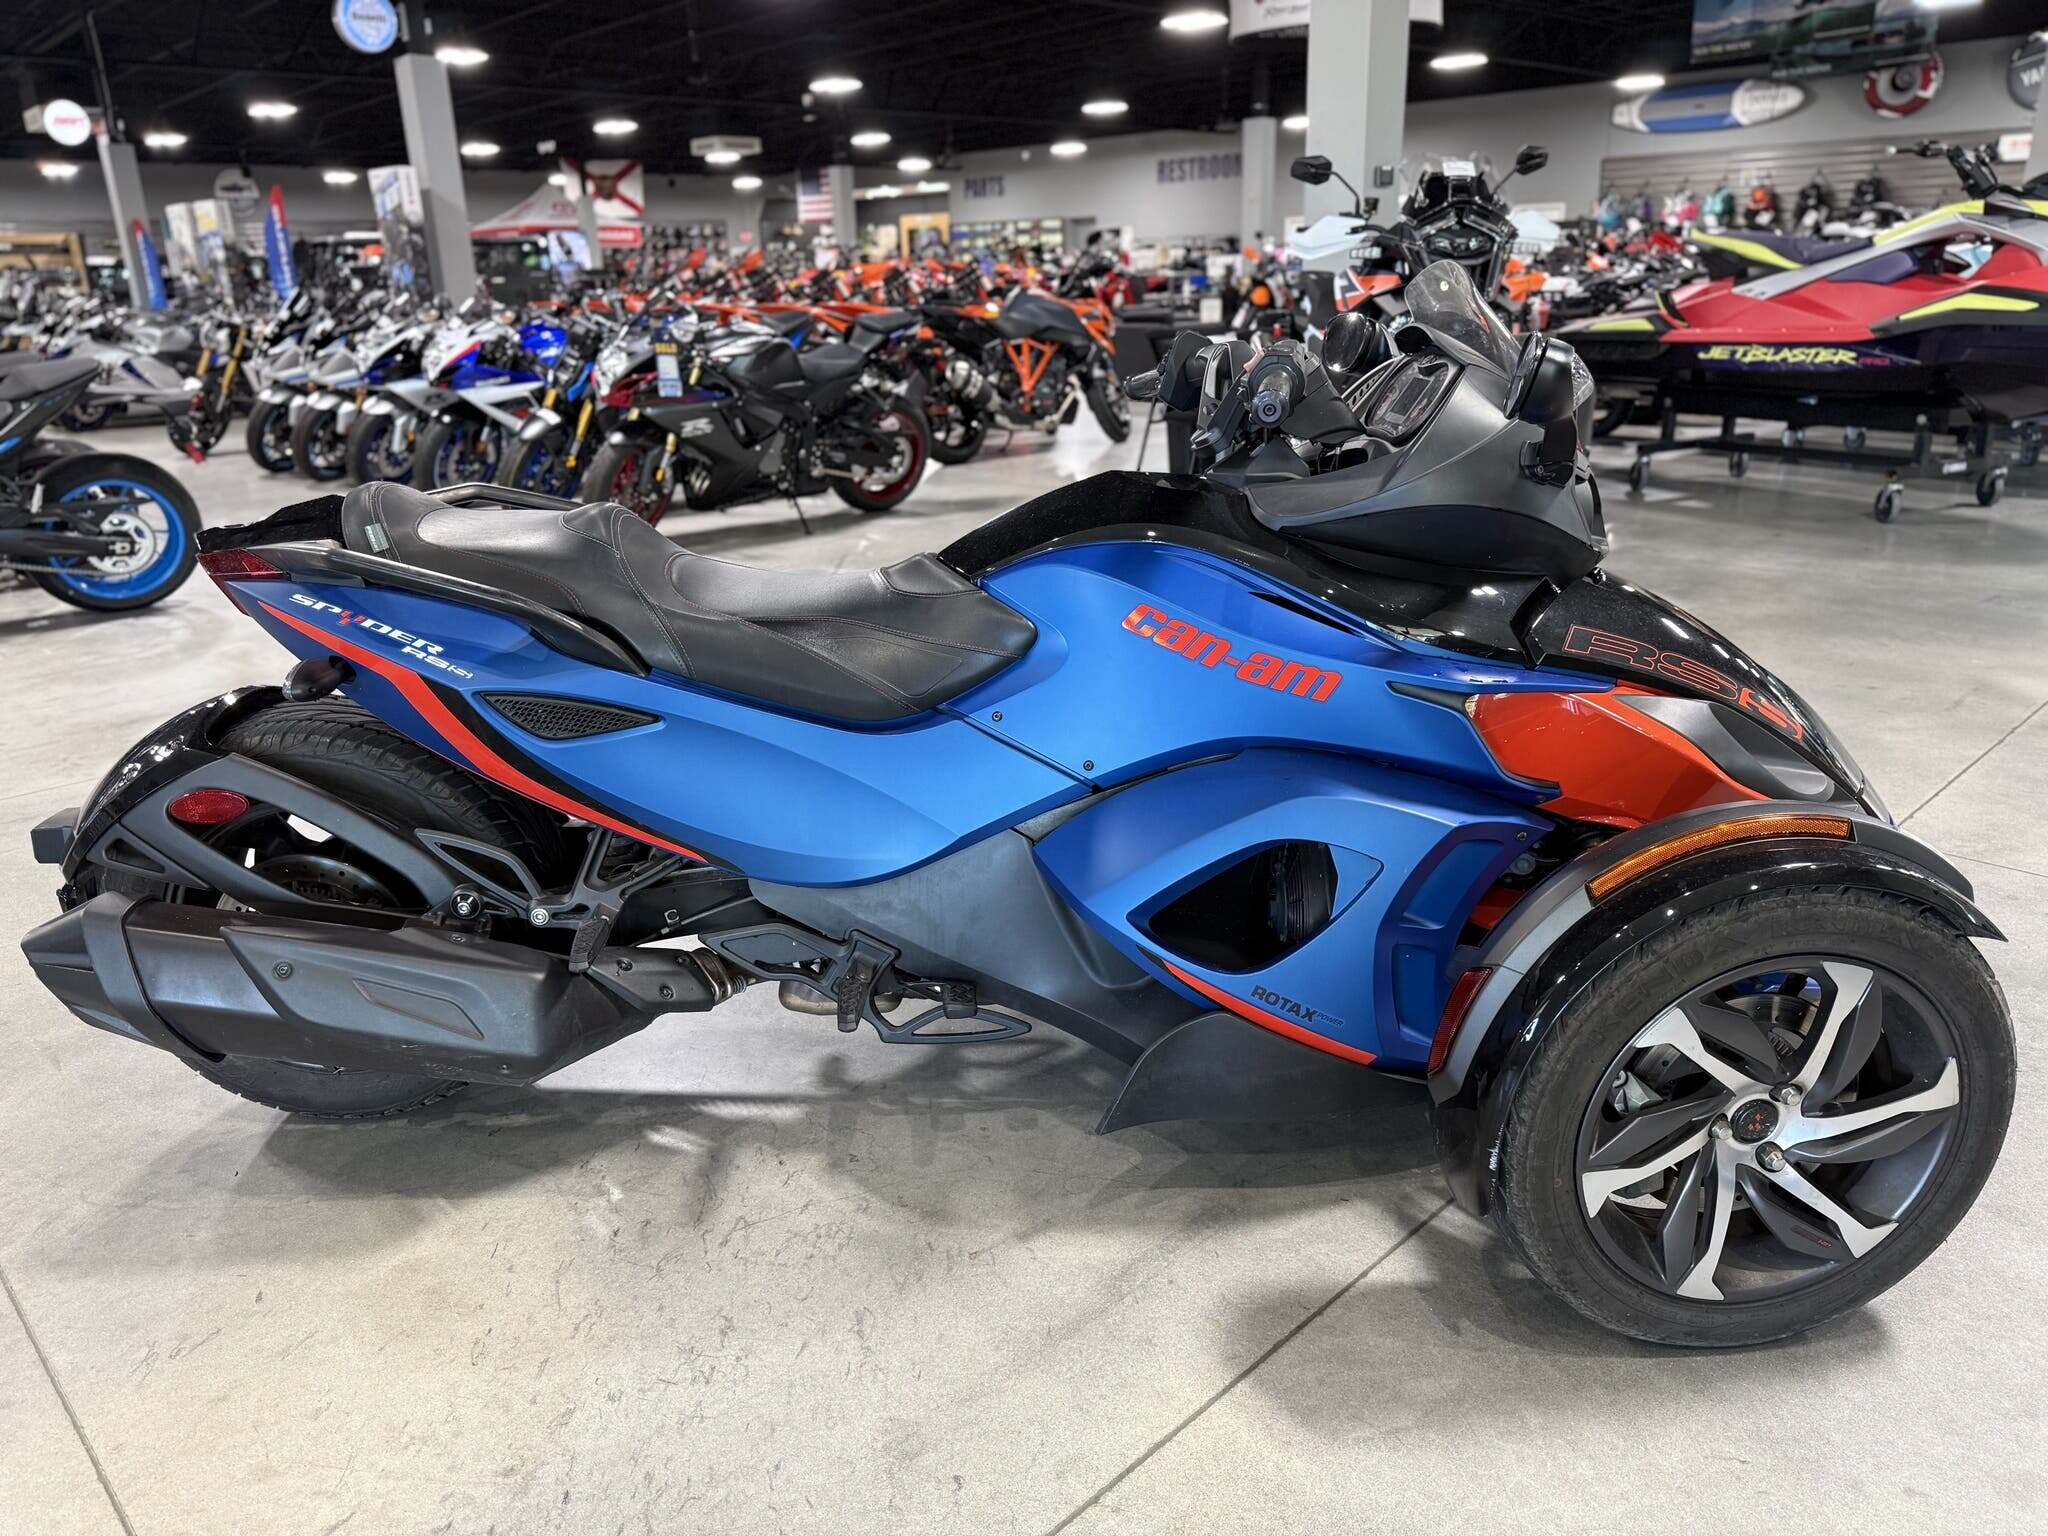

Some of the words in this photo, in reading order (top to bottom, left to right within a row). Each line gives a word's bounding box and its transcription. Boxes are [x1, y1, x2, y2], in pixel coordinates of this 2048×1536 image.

[964, 176, 1005, 199] PARTS
[289, 593, 445, 655] SPYDER
[1250, 985, 1318, 1022] ROTAX
